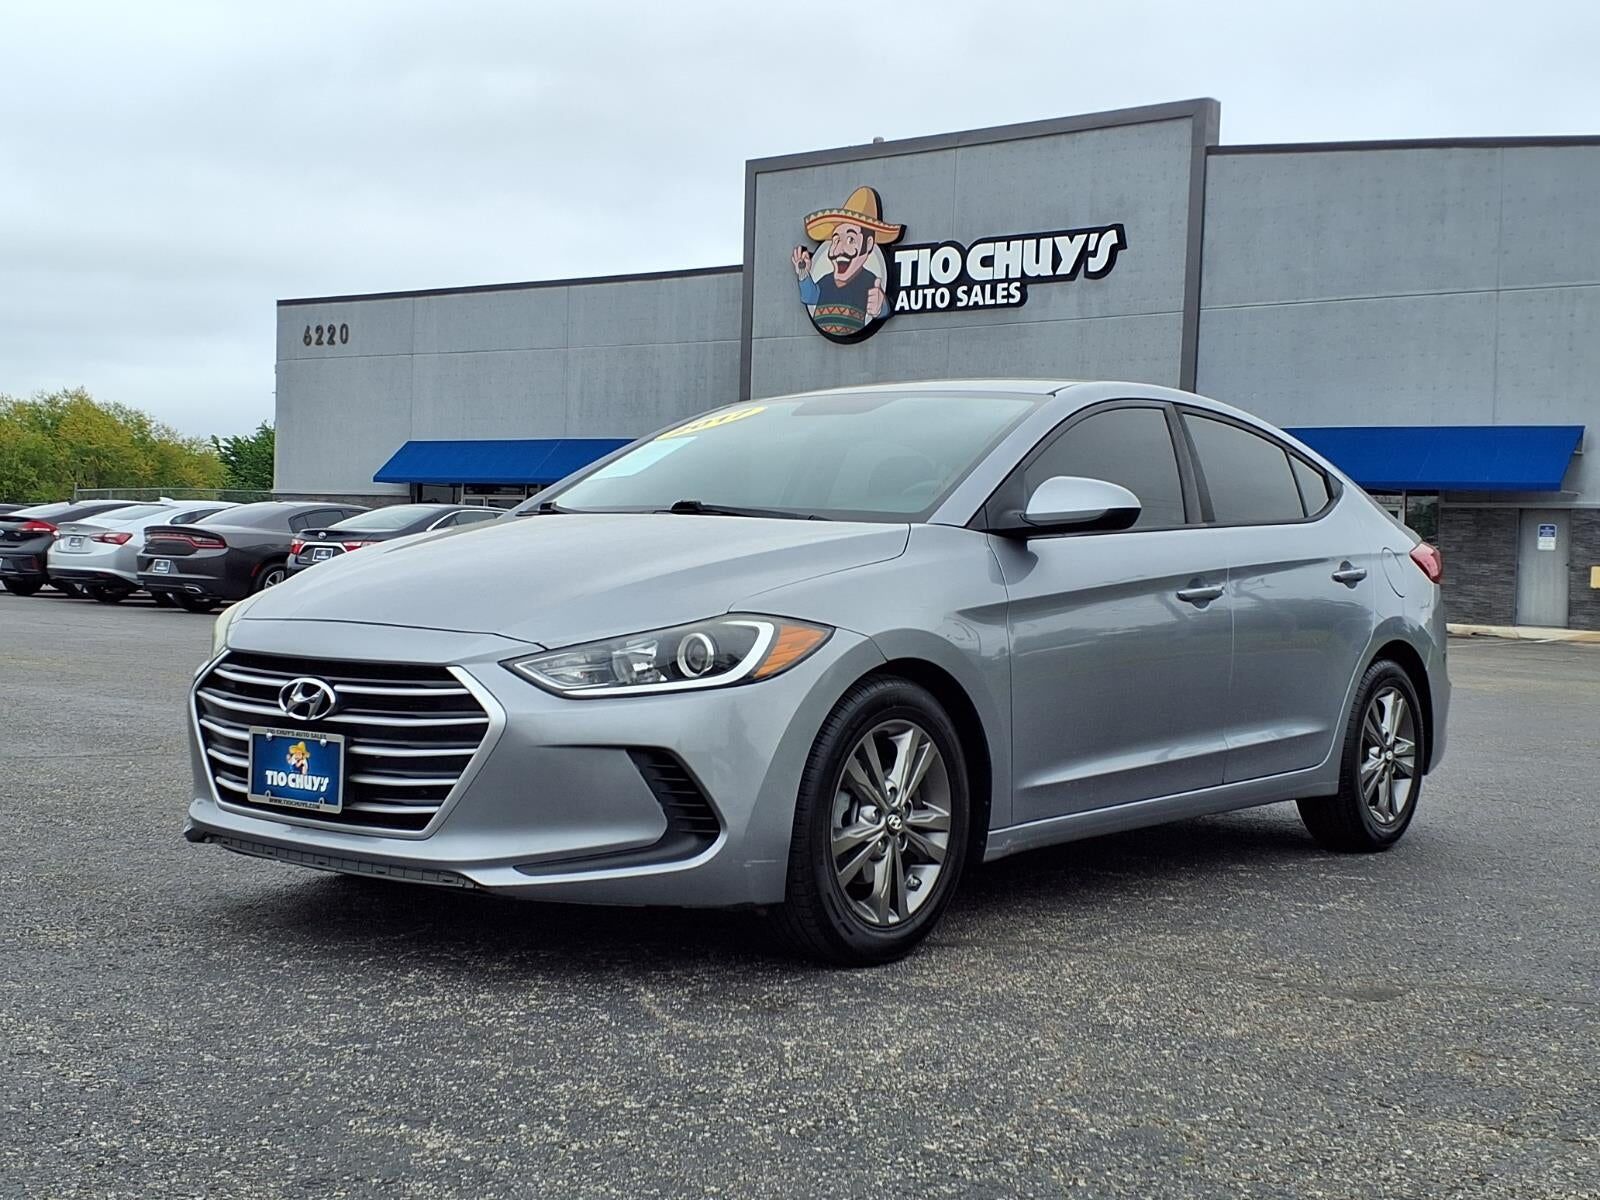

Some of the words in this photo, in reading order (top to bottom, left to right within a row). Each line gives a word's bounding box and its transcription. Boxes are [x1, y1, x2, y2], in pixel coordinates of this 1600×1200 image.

[895, 246, 962, 287] TIO
[966, 229, 1118, 281] CHUY'S
[895, 287, 950, 311] AUTO
[956, 282, 1021, 306] SALES
[303, 323, 349, 346] 6220
[265, 770, 287, 787] TIO
[287, 773, 329, 792] CHUY'S
